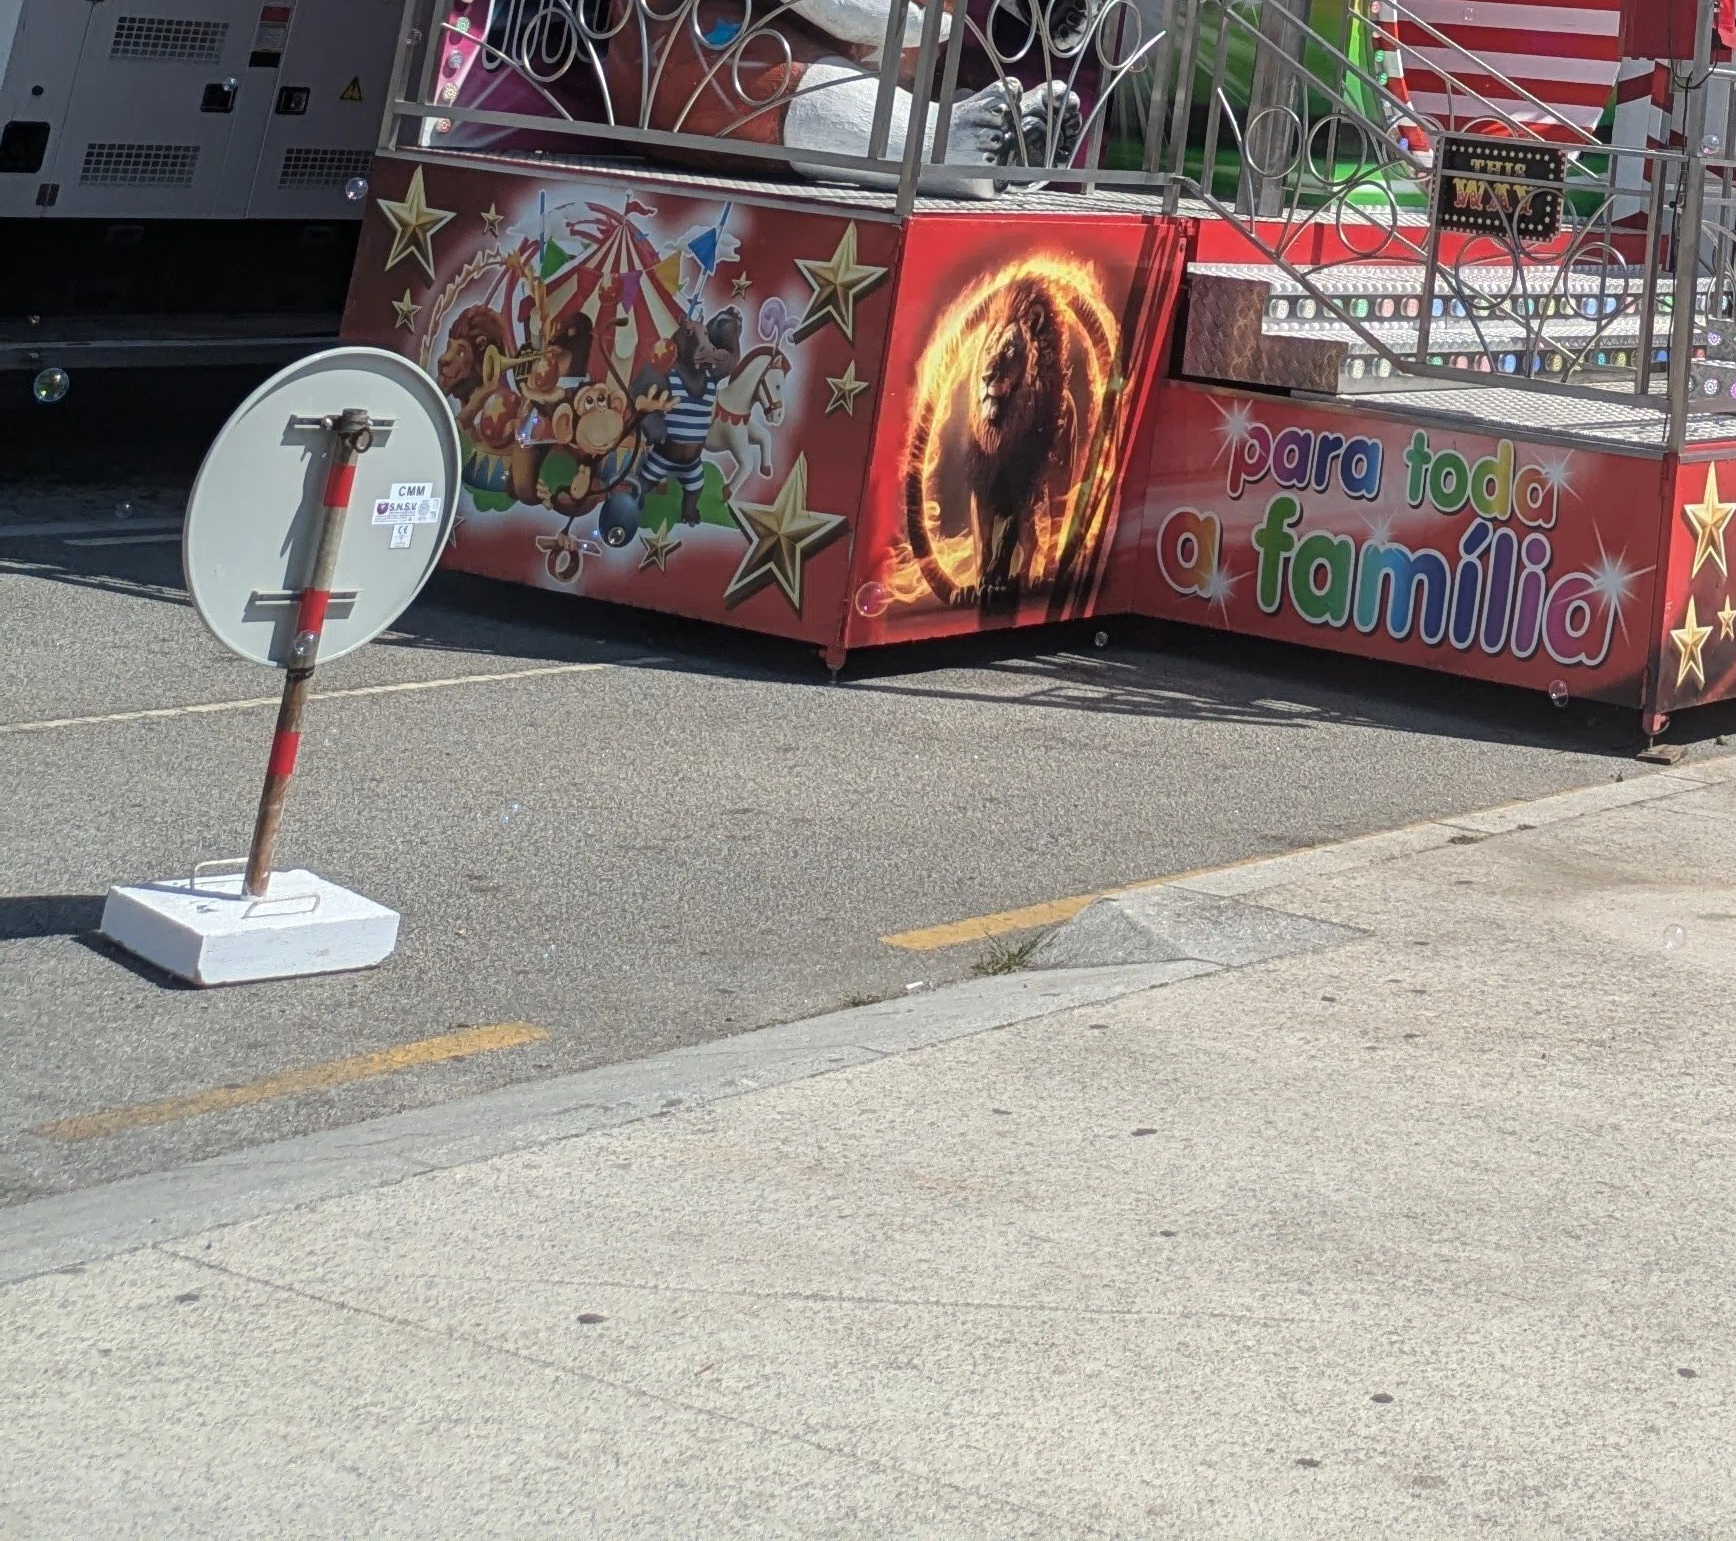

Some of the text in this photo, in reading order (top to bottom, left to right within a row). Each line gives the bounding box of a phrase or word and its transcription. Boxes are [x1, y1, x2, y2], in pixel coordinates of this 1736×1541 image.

[1470, 158, 1527, 178] THIS
[1452, 177, 1541, 217] WAY
[398, 485, 426, 497] CMM
[1226, 422, 1561, 529] para toda
[1157, 495, 1622, 667] a família
